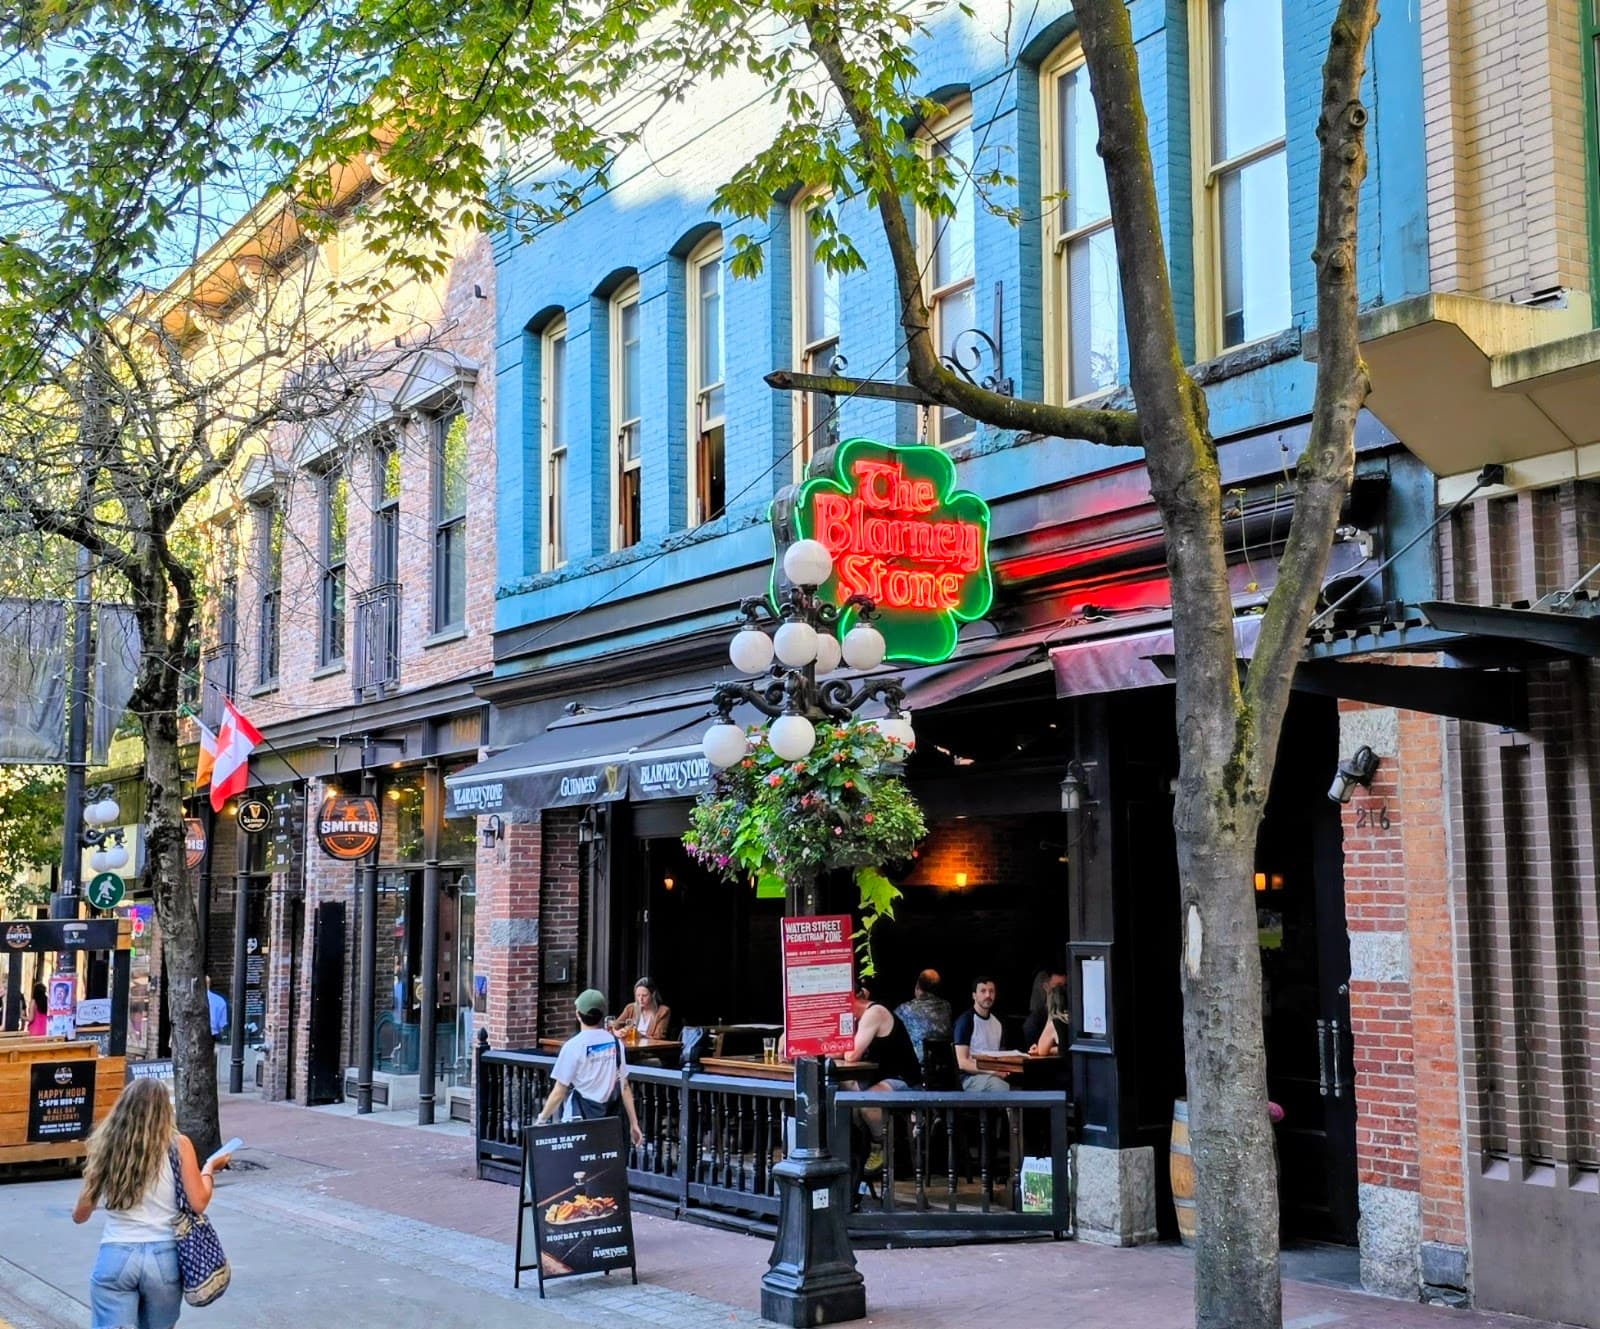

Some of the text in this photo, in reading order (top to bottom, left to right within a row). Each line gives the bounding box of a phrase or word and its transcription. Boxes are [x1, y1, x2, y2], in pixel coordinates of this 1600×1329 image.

[854, 460, 939, 512] The
[814, 493, 981, 572] Blarney
[839, 554, 965, 608] Stone
[560, 775, 598, 797] GUINNESS
[1356, 806, 1390, 830] 216
[321, 820, 378, 835] SMITHS
[785, 920, 841, 934] WATER STREET
[786, 931, 842, 943] PEDESTRIAN ZONE
[38, 1087, 86, 1100] HAPPY HOUR
[551, 1142, 573, 1151] HOUR
[560, 1134, 587, 1143] HAPPY
[546, 1225, 623, 1242] MONDAY TO FRIDAY
